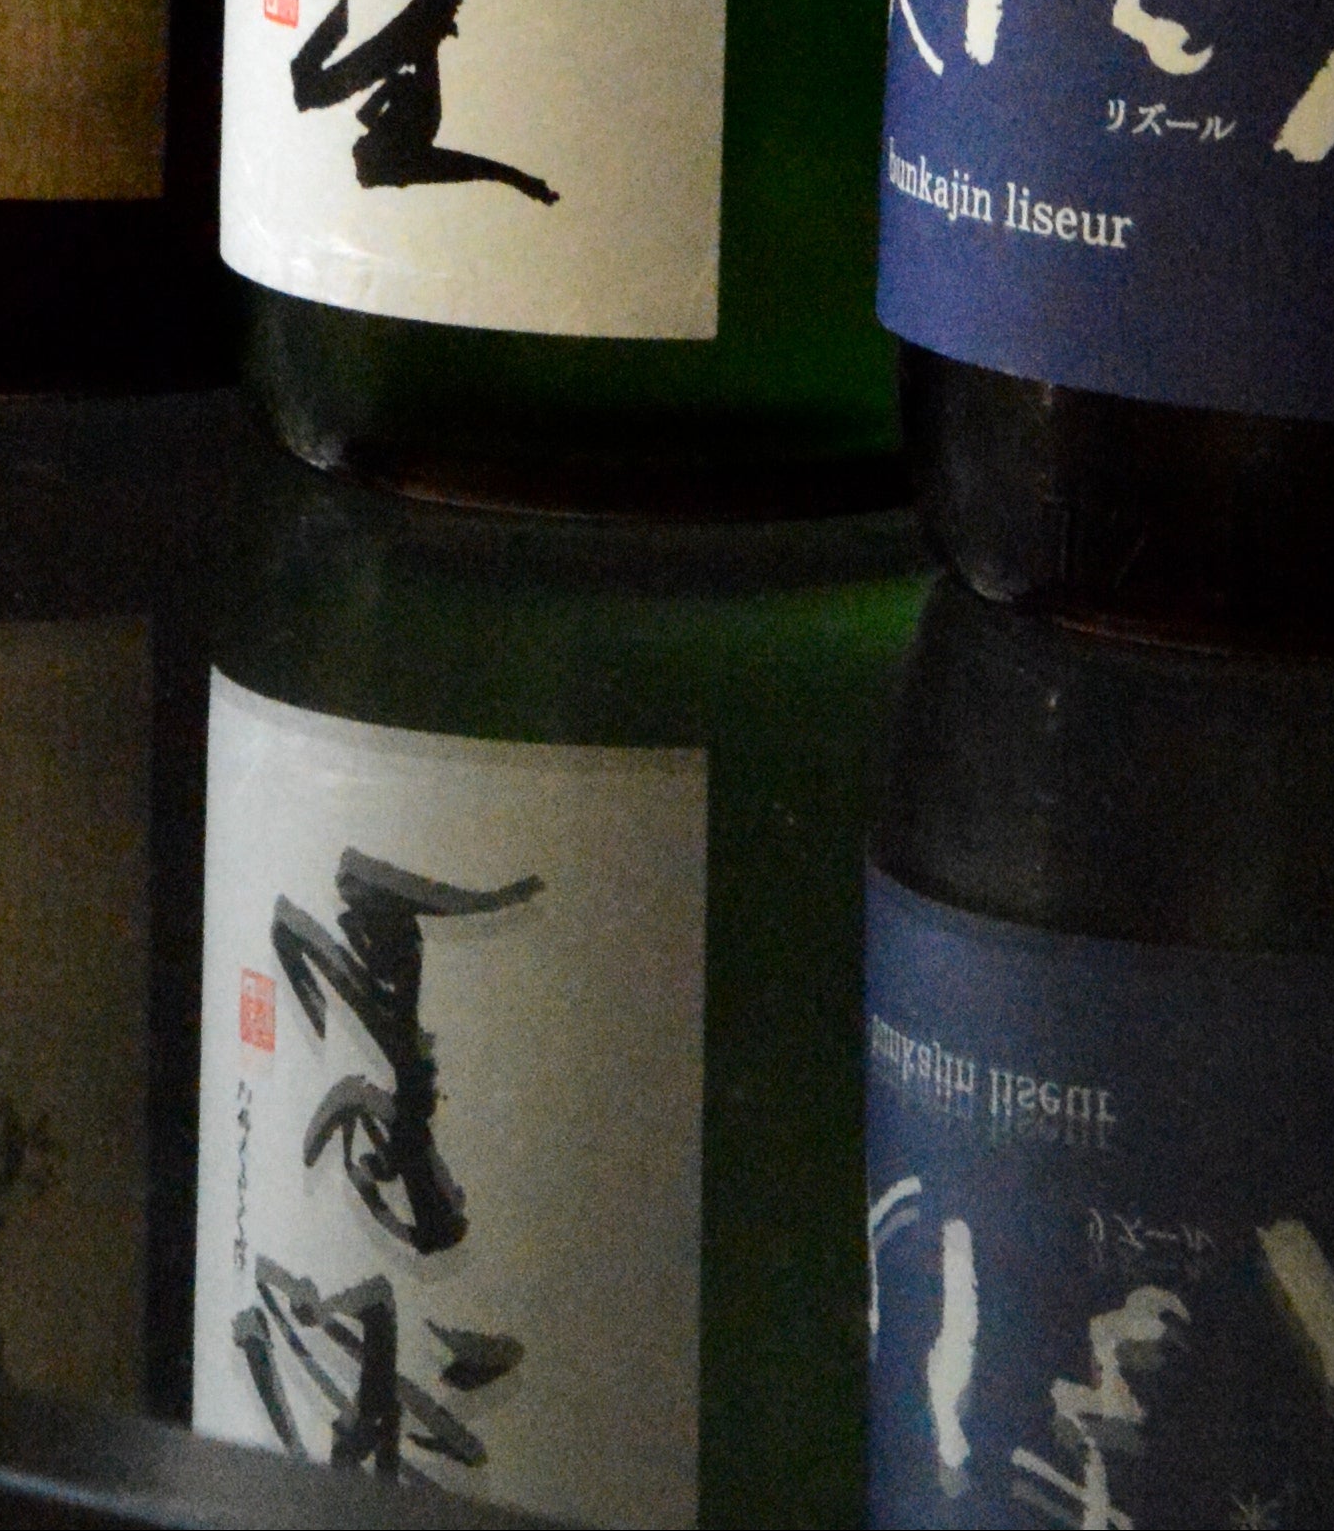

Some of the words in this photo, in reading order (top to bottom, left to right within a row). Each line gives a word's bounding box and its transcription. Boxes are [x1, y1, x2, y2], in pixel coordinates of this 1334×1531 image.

[1103, 97, 1237, 143] リズール
[1004, 181, 1136, 250] liseur
